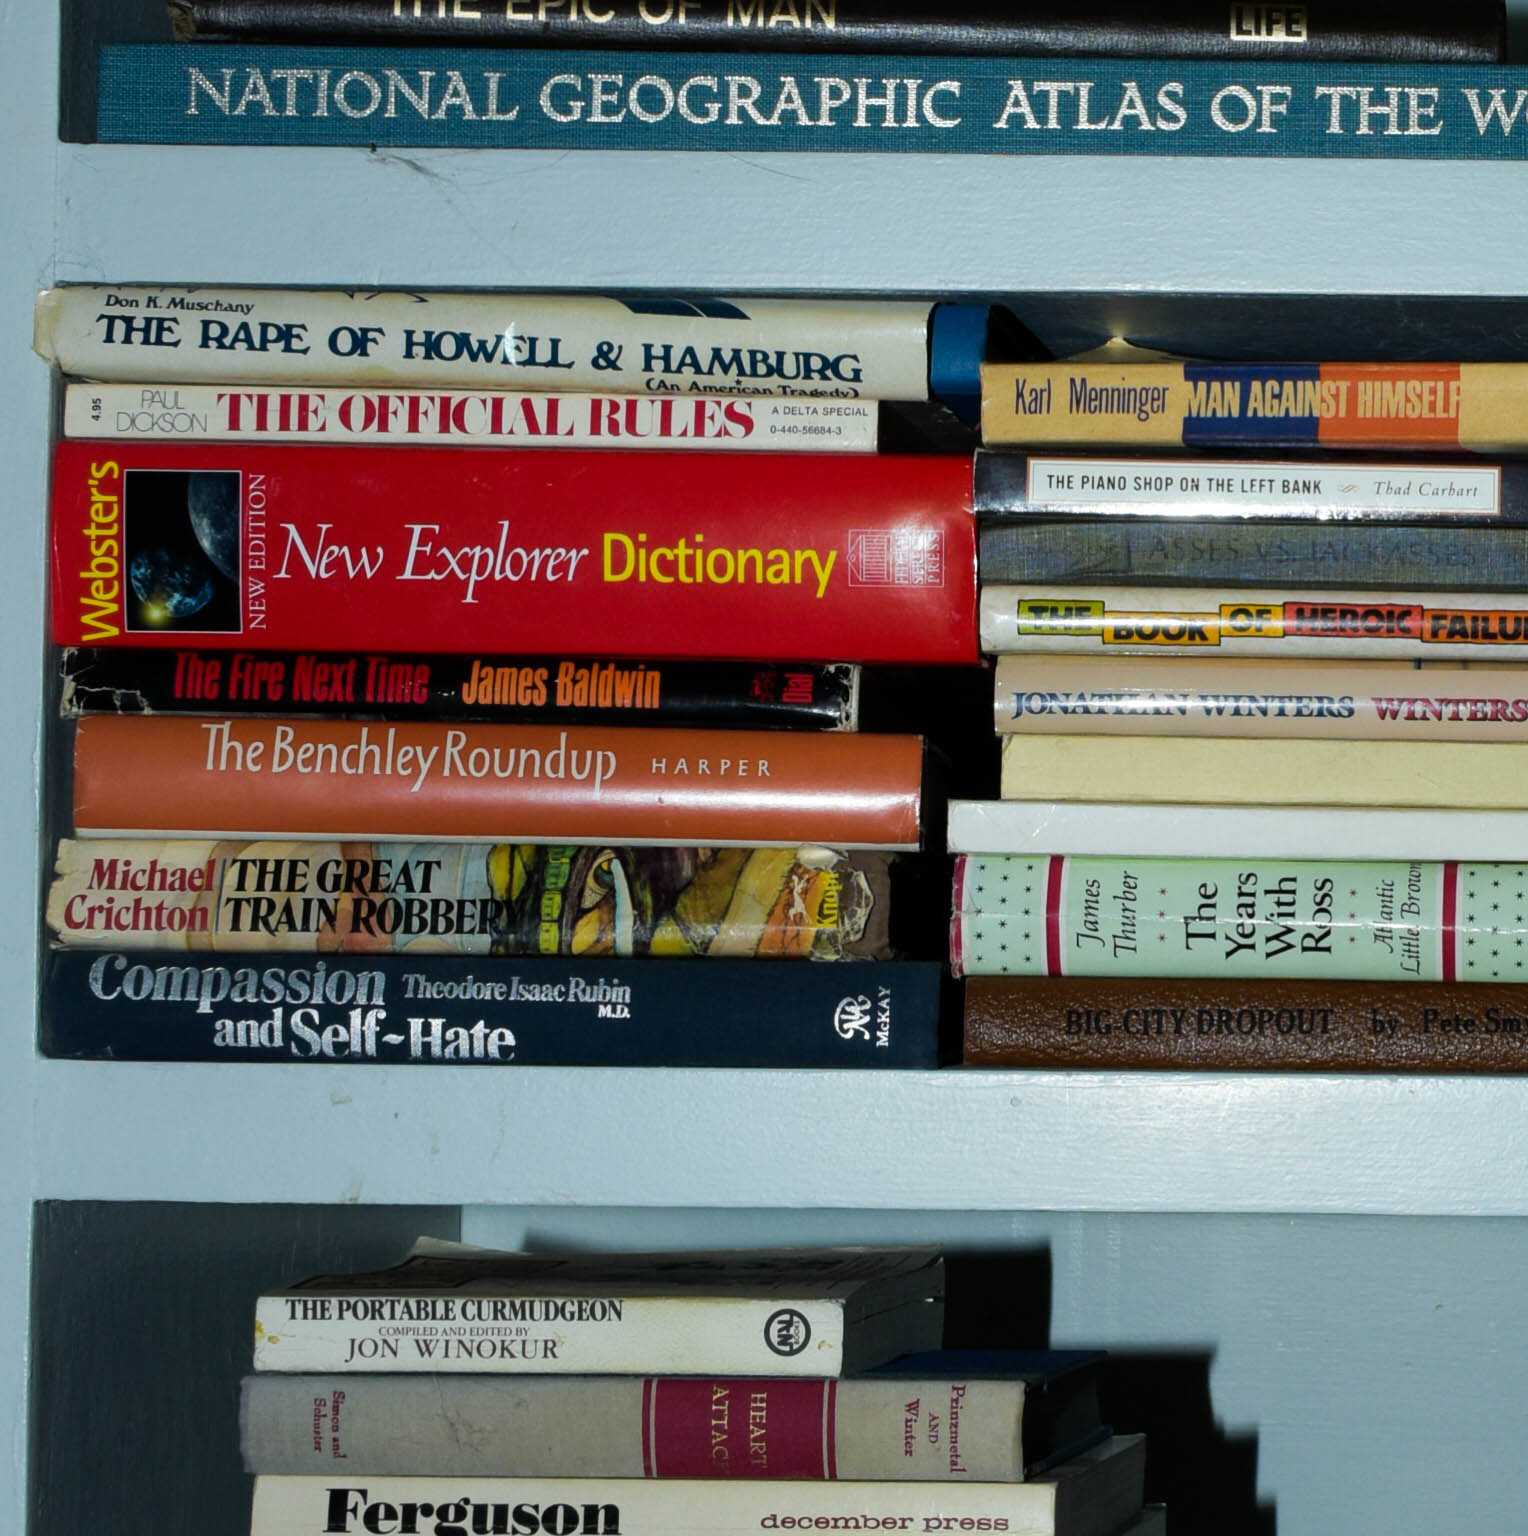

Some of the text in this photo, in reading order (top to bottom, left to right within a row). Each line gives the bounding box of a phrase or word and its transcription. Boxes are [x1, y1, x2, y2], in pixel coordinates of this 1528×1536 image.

[186, 66, 519, 121] NATIONAL
[539, 72, 961, 128] GEOGRAPHIC
[993, 78, 1187, 132] ATLAS
[1211, 84, 1293, 135] OF
[1316, 86, 1444, 137] THE
[96, 314, 862, 382] THE RAPE OF HOWELL & HAMBURG
[92, 397, 101, 422] 4.95
[218, 393, 754, 438] THE OFFICIAL RULES
[772, 406, 868, 417] A DELTA SPECIAL
[770, 424, 842, 436] 0-440-56684-3
[1047, 474, 1322, 495] THE PIANO SHOP ON THE LEFT BANK
[1375, 479, 1479, 498] Thad Carhart
[80, 459, 120, 641] Webster's
[273, 522, 384, 580] New
[396, 520, 589, 603] Explorer
[603, 532, 837, 599] Dictionary
[462, 660, 661, 710] James Baldwin
[202, 721, 617, 799] The Benchley Roundup
[651, 758, 771, 777] HARPER
[88, 856, 215, 892] Michael
[231, 858, 441, 895] THE GREAT
[64, 895, 209, 932] Crichton
[225, 897, 526, 937] TRAIN ROBBERY
[876, 985, 891, 1047] McKAY
[345, 1338, 558, 1363] JON WINOKUR
[760, 1514, 1010, 1534] december press
